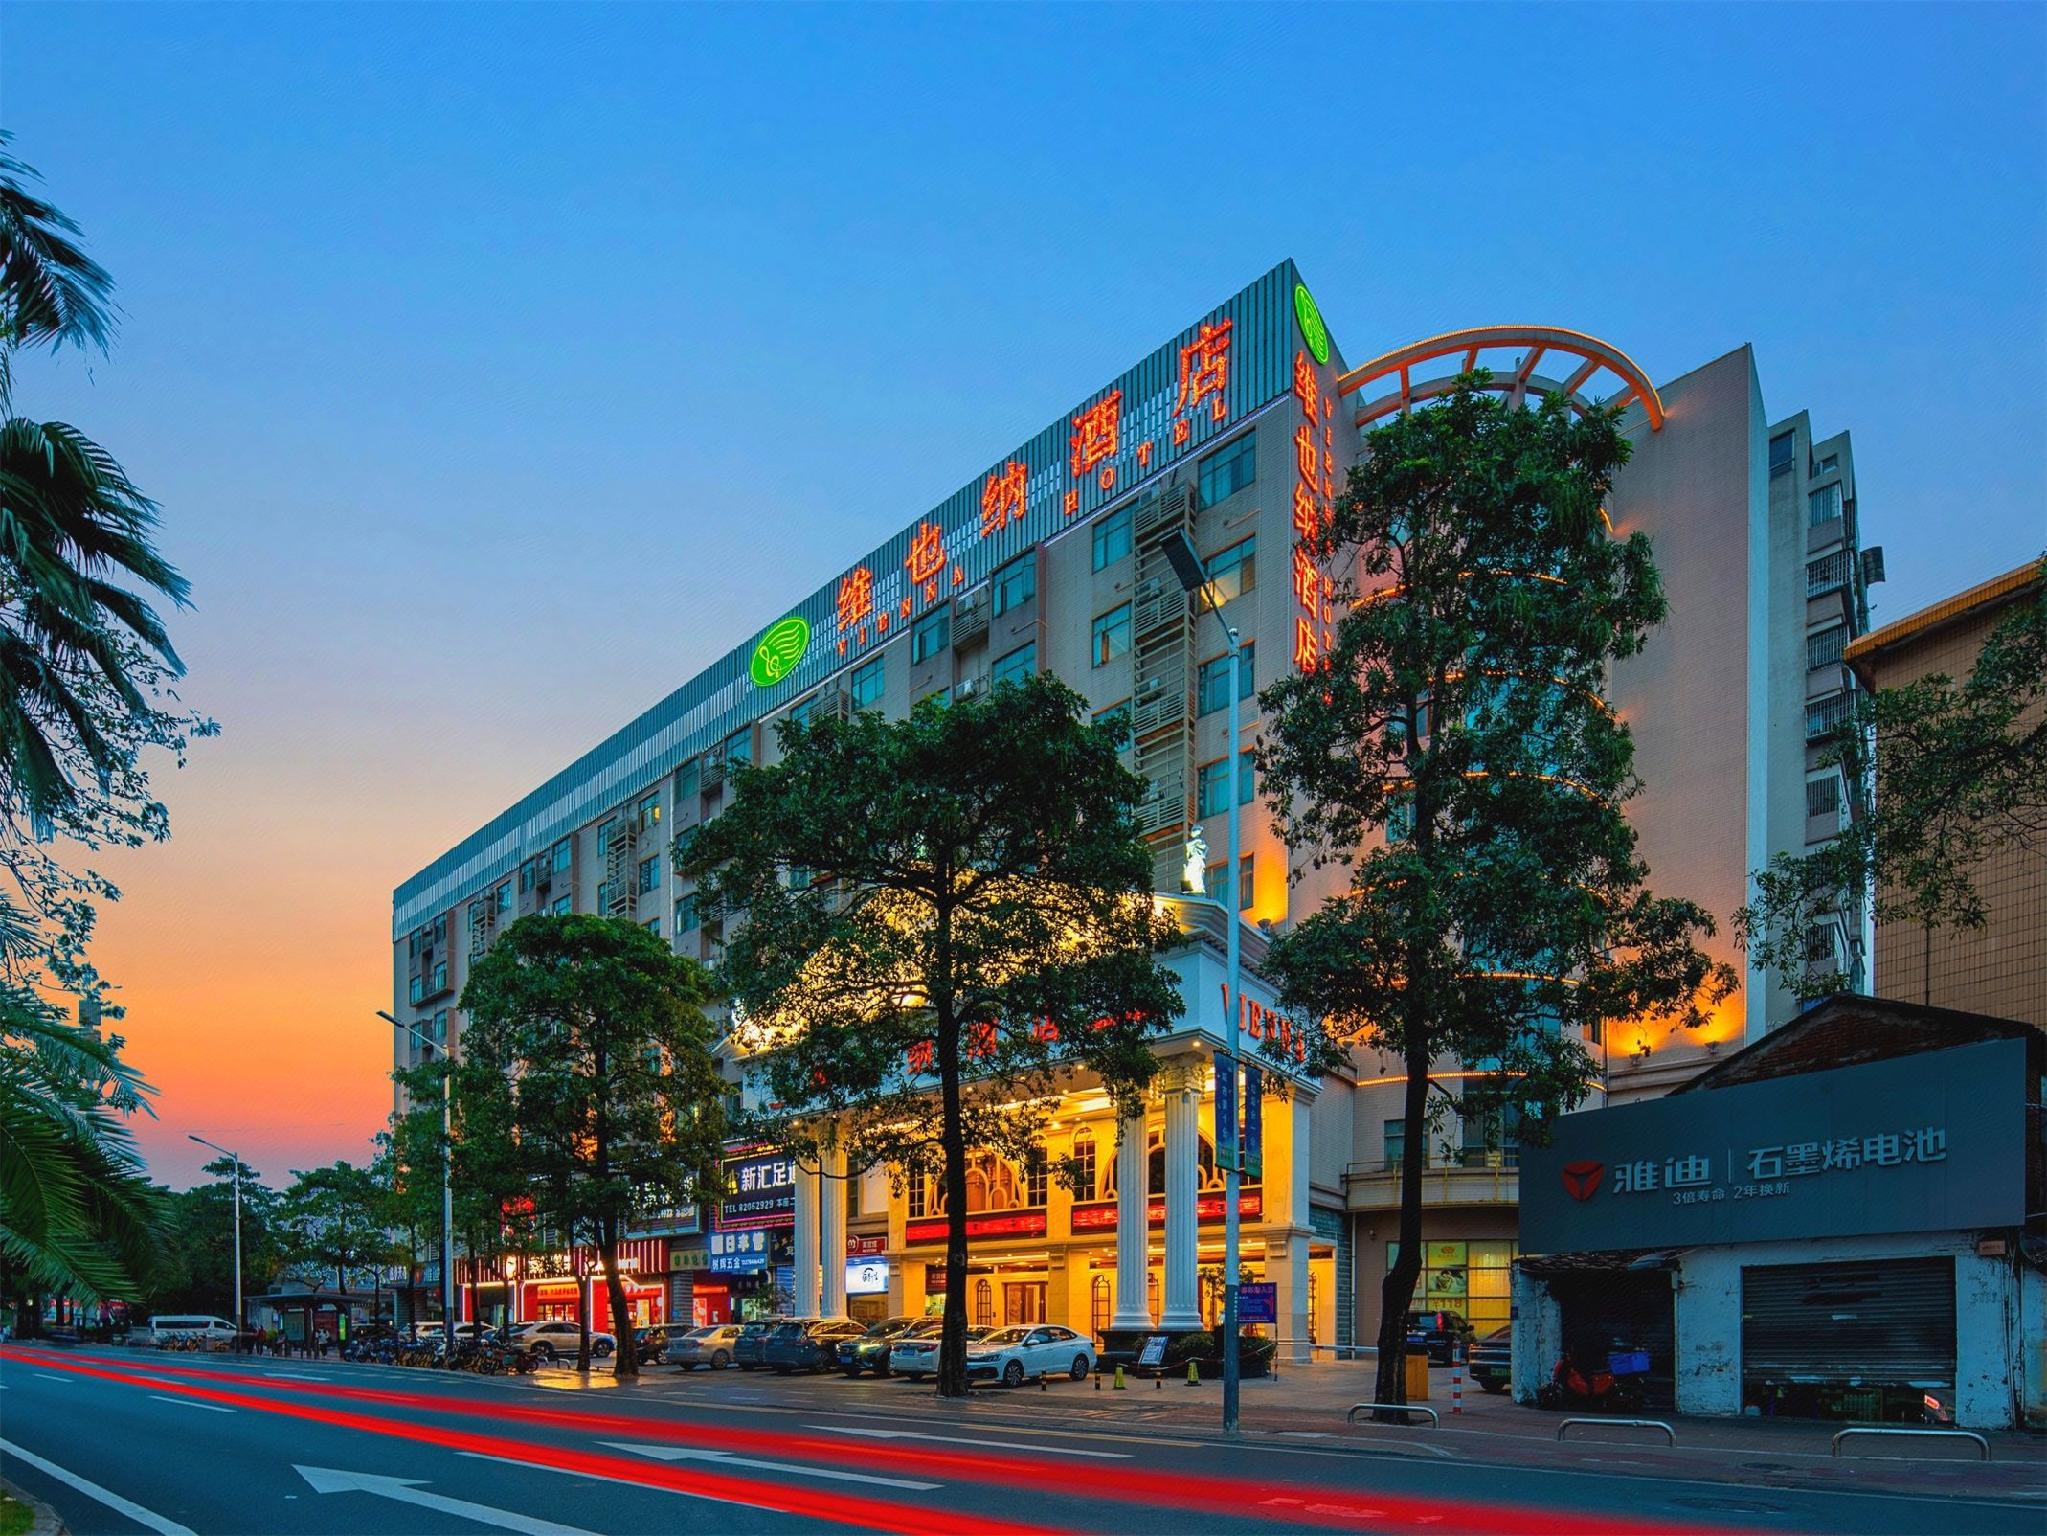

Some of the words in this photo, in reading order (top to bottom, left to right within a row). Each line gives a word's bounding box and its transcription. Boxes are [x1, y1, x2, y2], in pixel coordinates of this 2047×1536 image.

[837, 317, 1233, 632] 维也纳酒店
[837, 565, 964, 656] VIENNA
[1064, 396, 1227, 516] HOTEL
[1293, 350, 1319, 673] 维也纳酒店
[724, 1204, 737, 1214] TEL
[1613, 1154, 1711, 1194] 雅迪
[1747, 1126, 1947, 1180] 石墨烯电池
[1672, 1187, 1725, 1206] 3倍寿命
[1733, 1181, 1791, 1200] 2年换新
